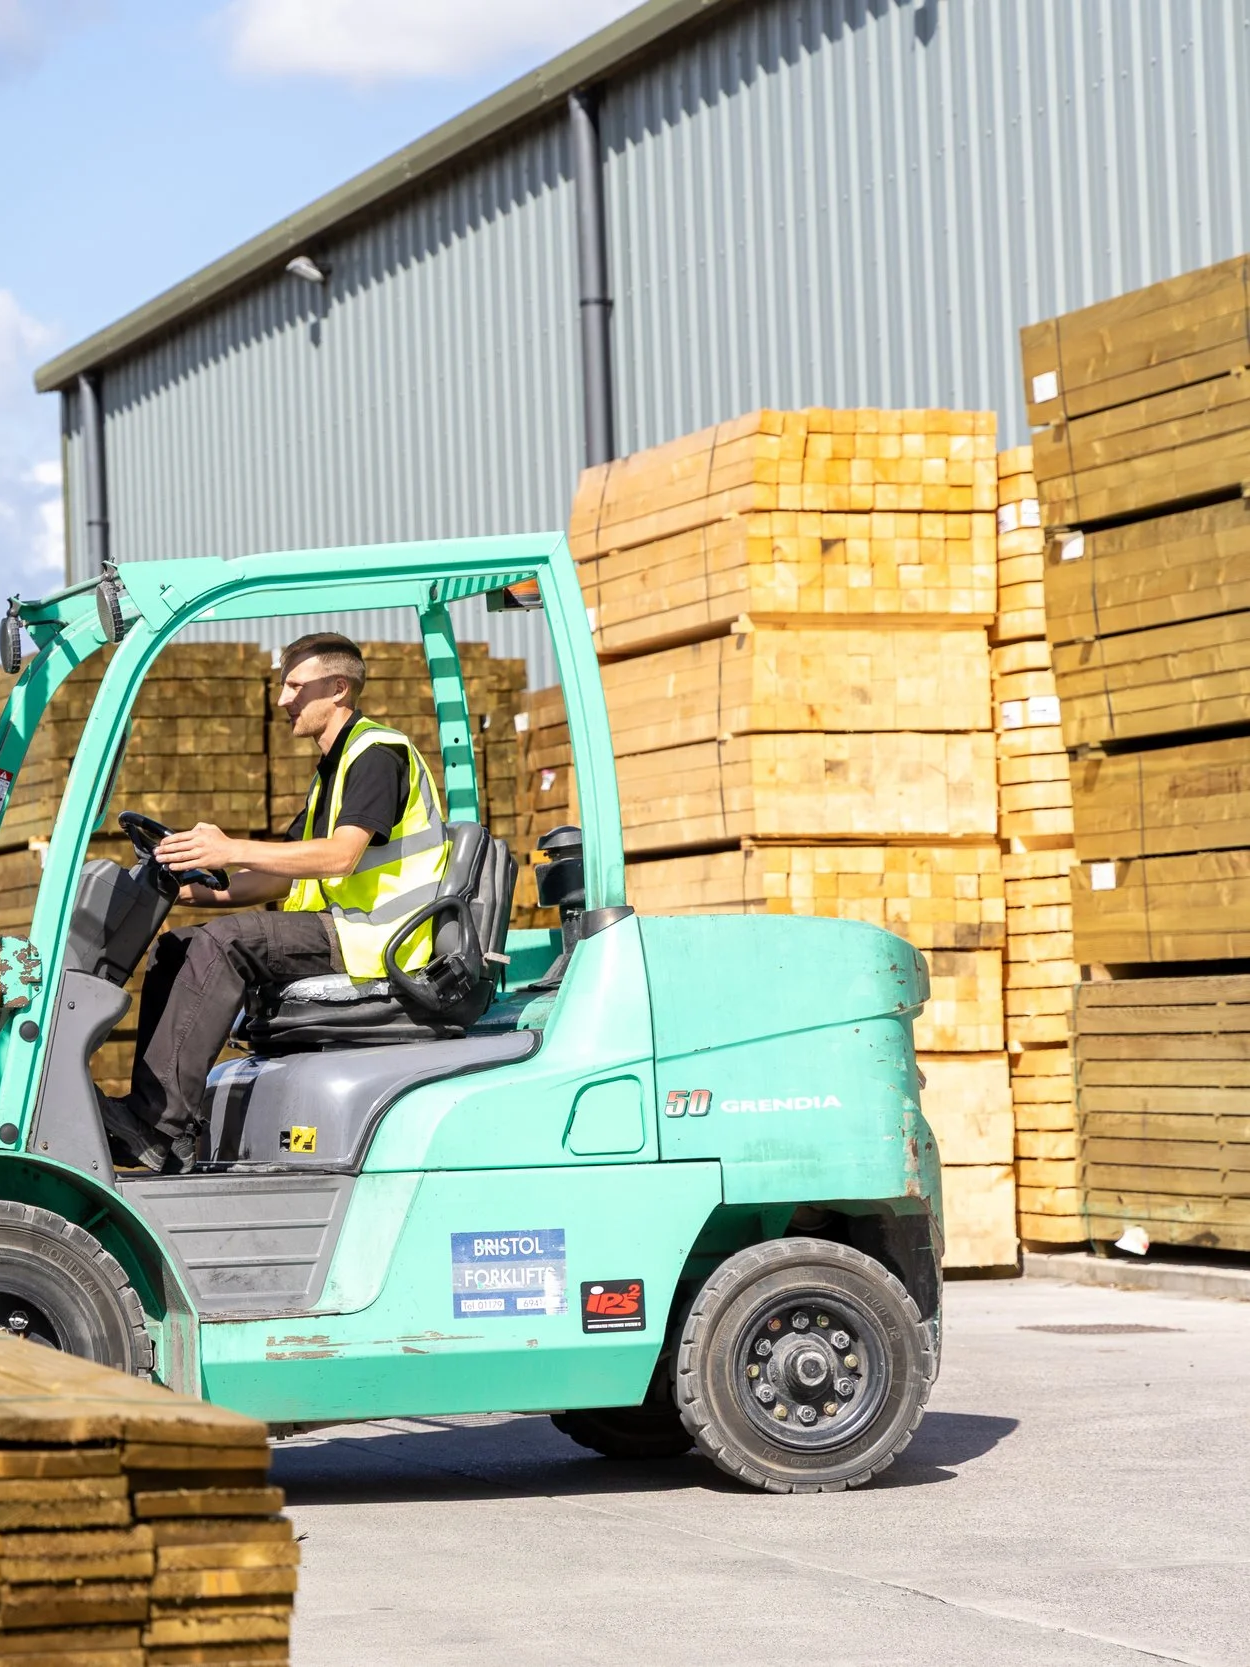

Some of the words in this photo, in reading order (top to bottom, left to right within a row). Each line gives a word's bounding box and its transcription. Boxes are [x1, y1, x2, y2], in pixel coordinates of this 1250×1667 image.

[664, 1089, 713, 1118] 50
[720, 1095, 842, 1114] GRENDIA
[473, 1236, 544, 1257] BRISTOL
[478, 1300, 503, 1310] 01179
